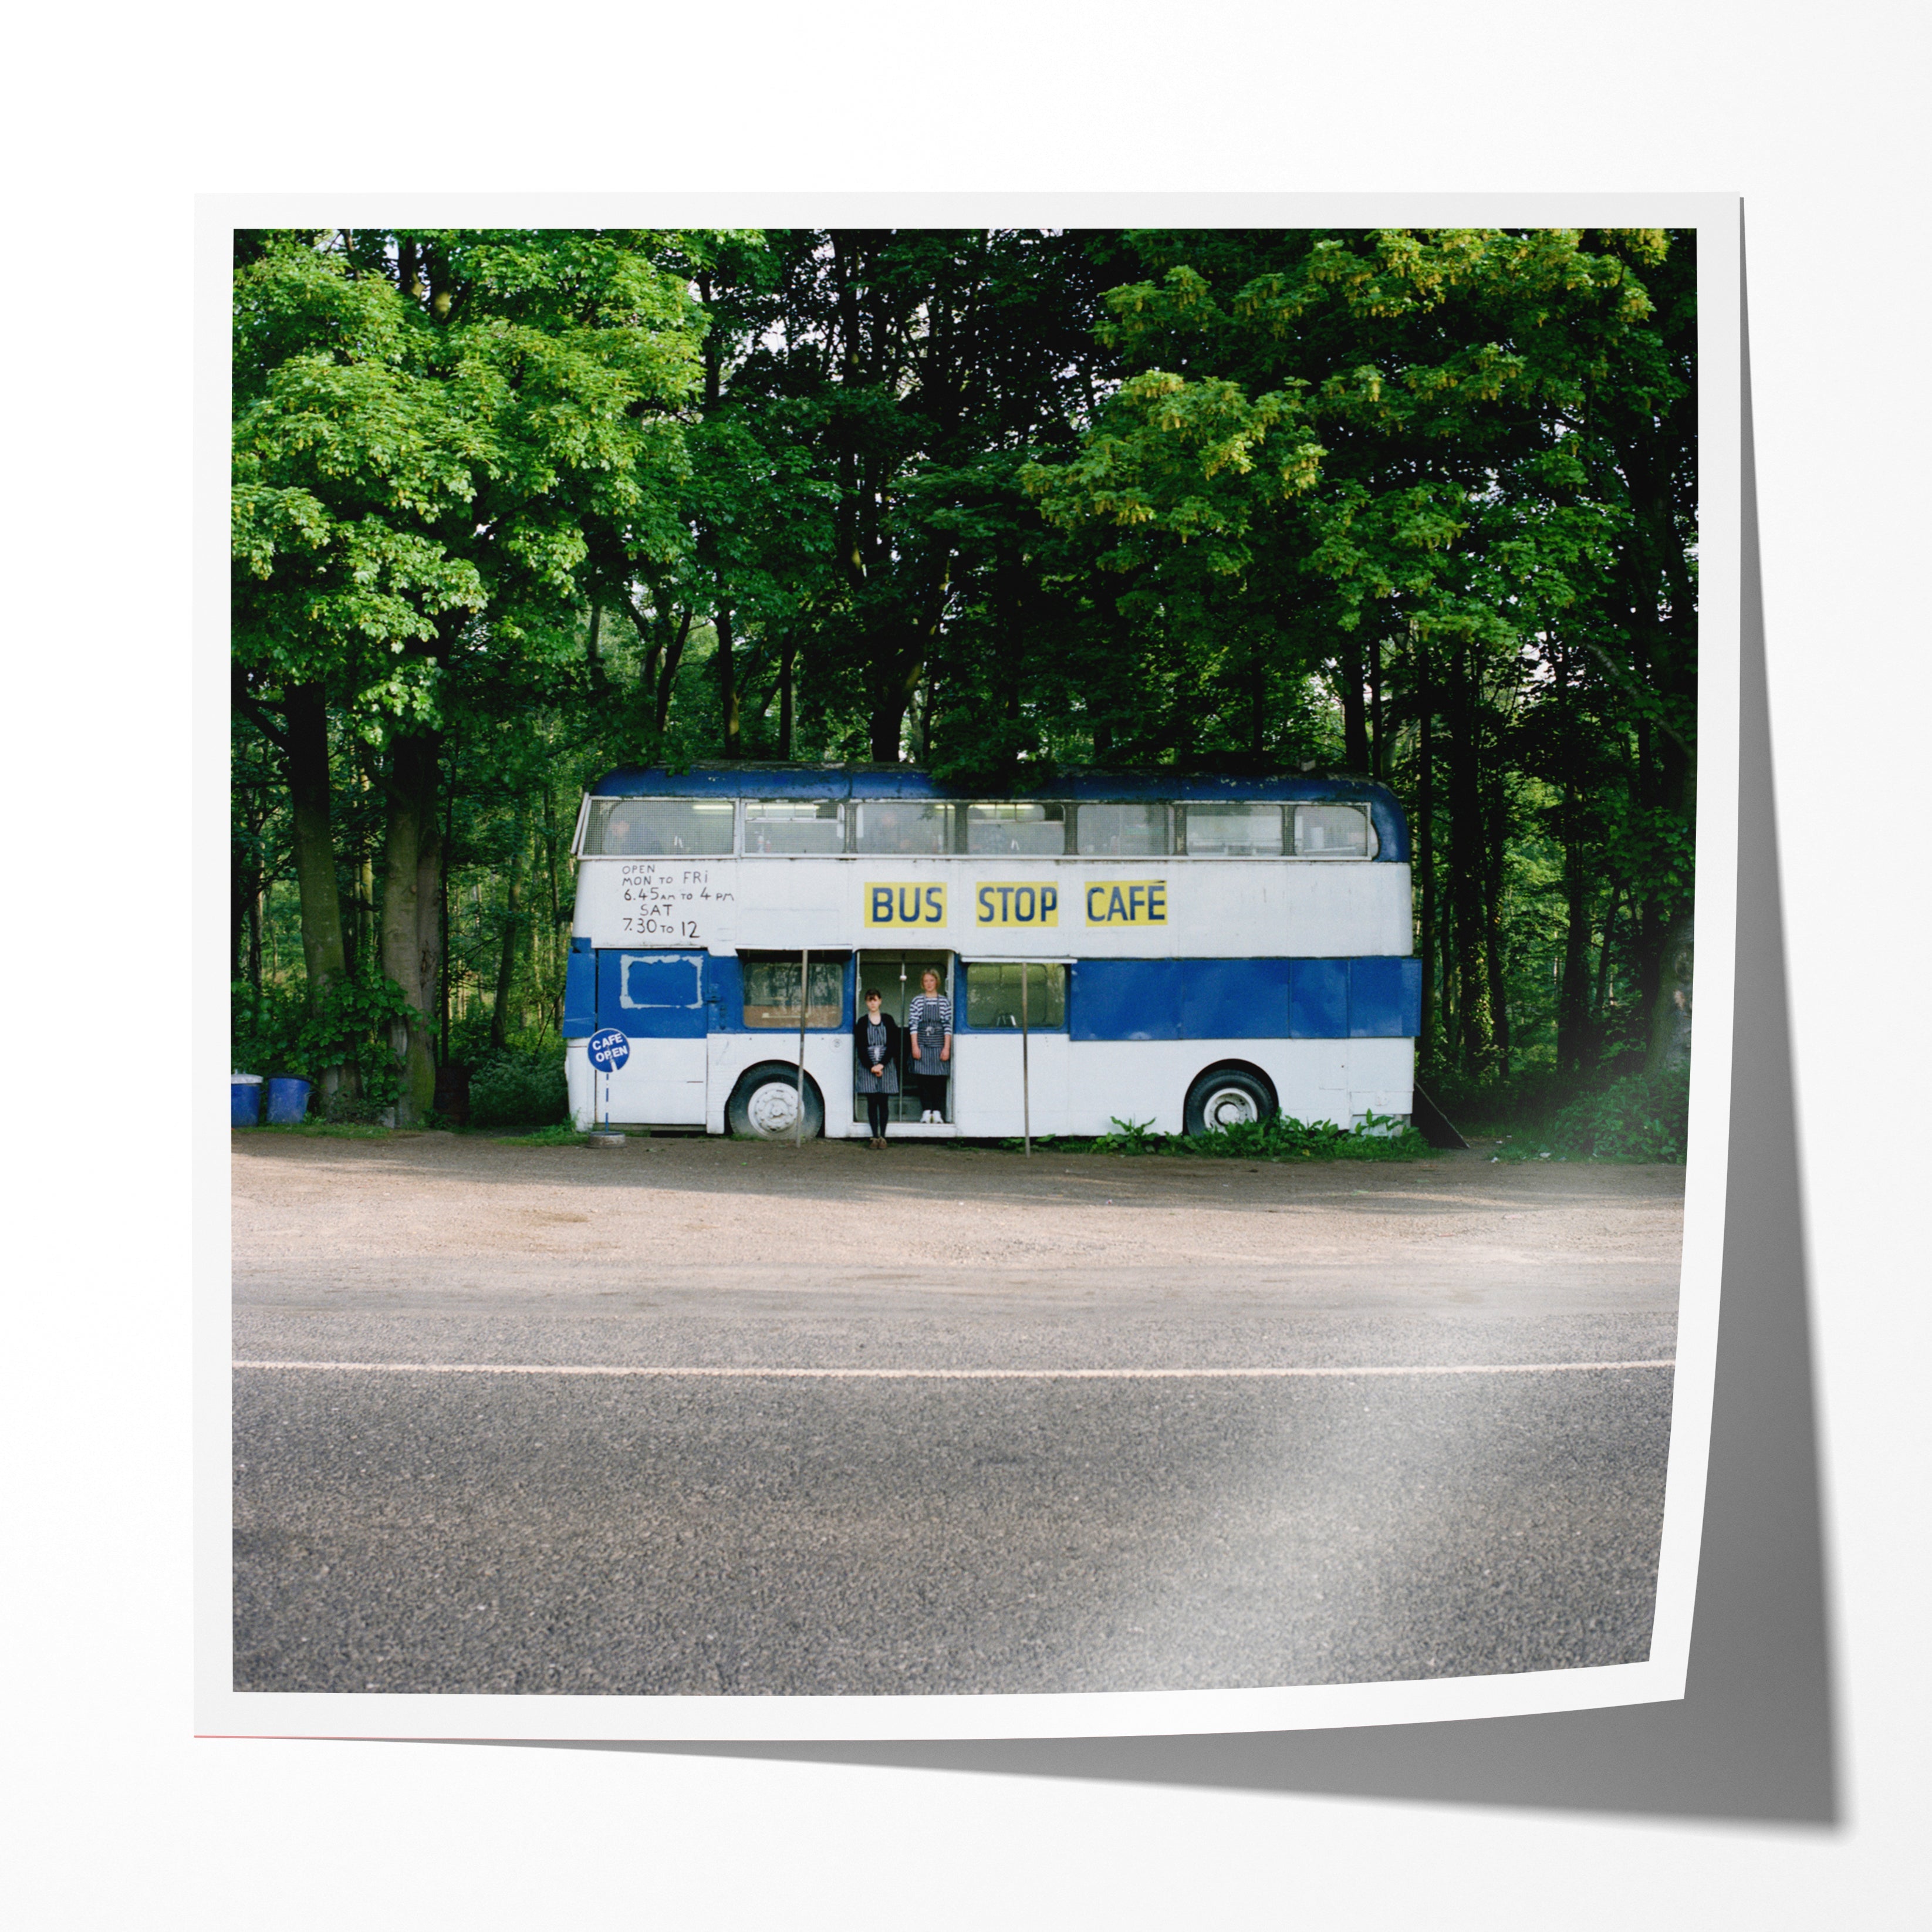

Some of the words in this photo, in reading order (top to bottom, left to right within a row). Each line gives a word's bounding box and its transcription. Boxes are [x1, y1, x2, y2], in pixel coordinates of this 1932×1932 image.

[622, 864, 656, 874] OPEN
[622, 876, 651, 886] MON
[700, 887, 711, 900] 4
[640, 904, 673, 916] SAT
[872, 887, 943, 923] BUS
[978, 886, 1057, 923] STOP
[623, 918, 657, 934] 7.30
[660, 925, 674, 933] TO
[681, 921, 701, 938] 12
[592, 1033, 623, 1051] CAFE
[596, 1045, 628, 1062] OPEN
